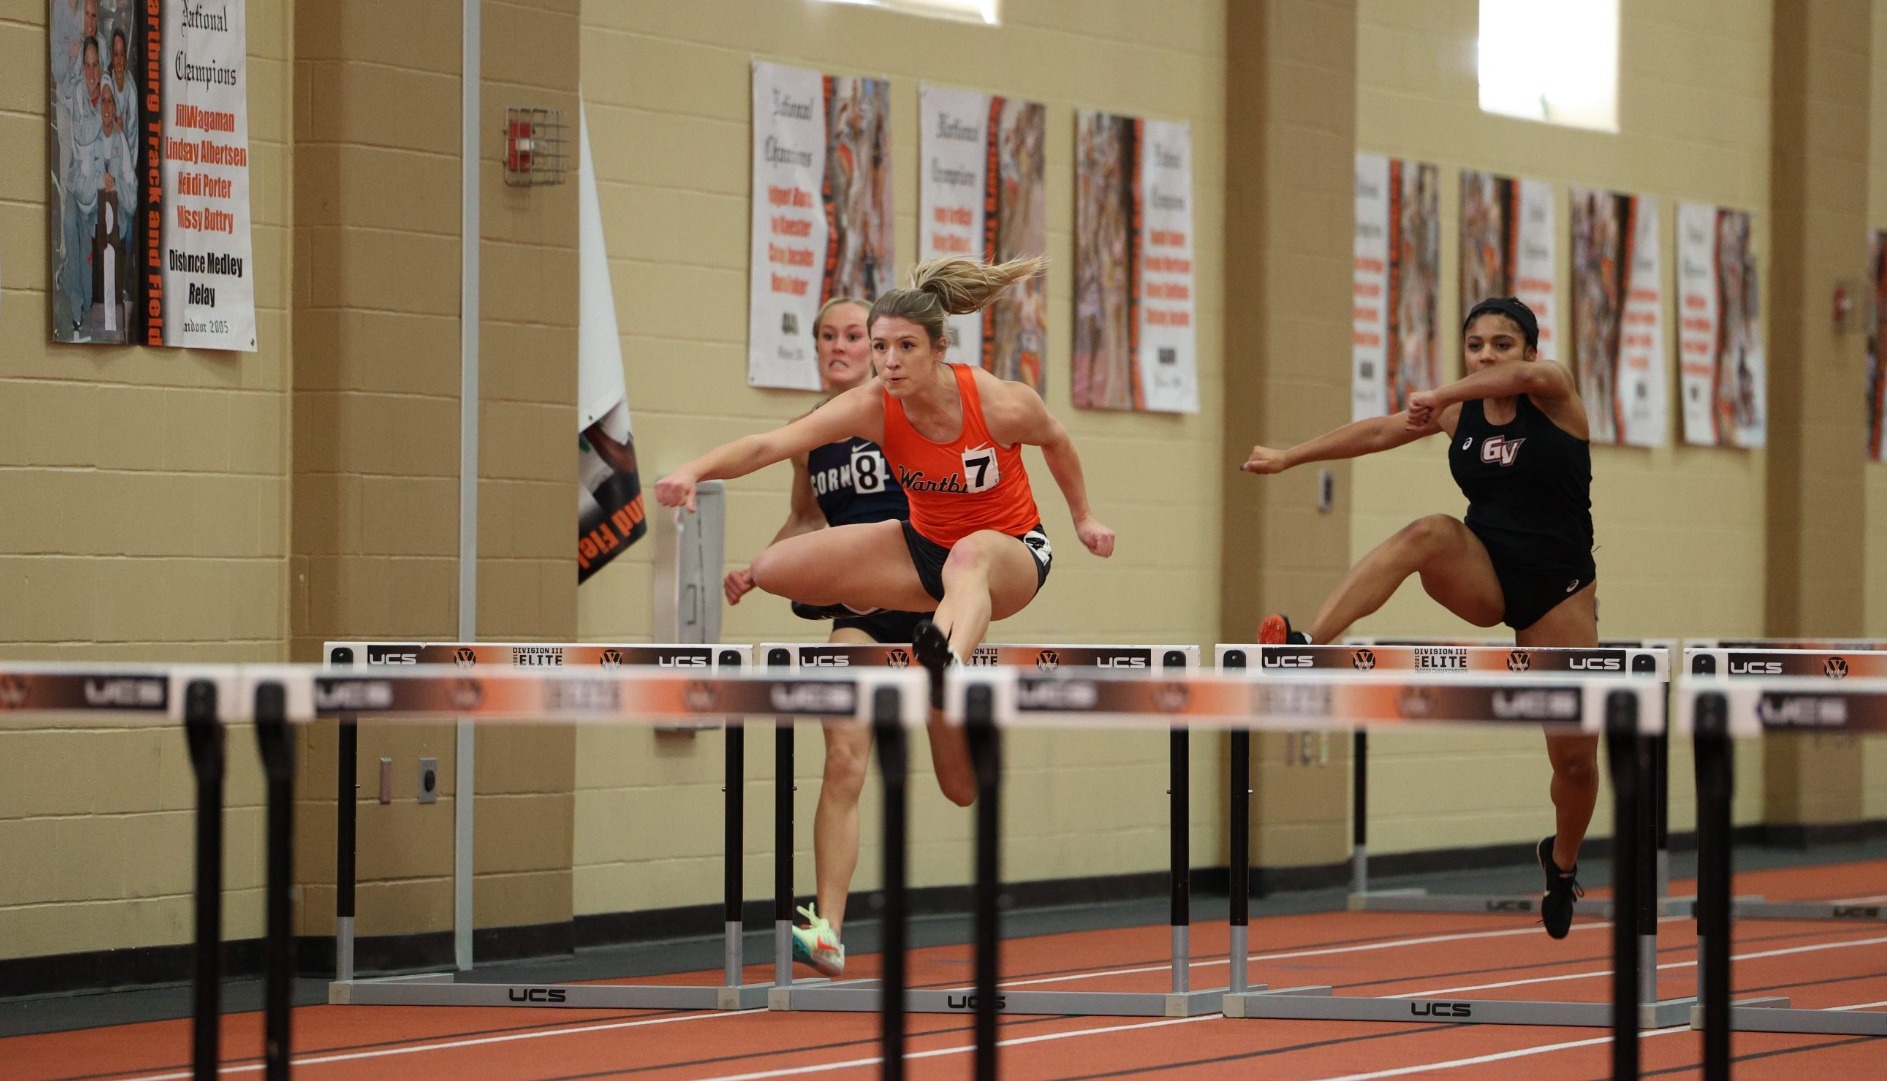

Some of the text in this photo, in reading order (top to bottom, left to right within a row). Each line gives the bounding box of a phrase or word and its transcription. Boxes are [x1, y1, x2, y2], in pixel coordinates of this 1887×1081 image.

[165, 136, 247, 167] Lindsay Albertsen
[148, 119, 162, 202] Track
[203, 174, 232, 199] Porter
[204, 207, 234, 235] Buttry
[148, 210, 161, 267] and
[207, 252, 243, 278] Medley
[188, 282, 216, 308] Relay
[148, 274, 163, 346] Field
[209, 320, 229, 334] 2005
[1481, 434, 1527, 467] GV
[810, 457, 891, 497] CORNL
[855, 454, 879, 491] 8
[965, 455, 991, 488] 7
[512, 647, 550, 655] DIVISION
[1414, 648, 1467, 656] DIVISION III
[368, 653, 417, 666] UCS
[519, 654, 563, 667] ELITE
[658, 656, 707, 668] UCS
[801, 655, 850, 668] UCS
[1096, 656, 1146, 669] UCS
[1264, 655, 1314, 668] UCS
[1421, 655, 1467, 668] ELITE
[1569, 657, 1620, 670] UCS
[1730, 661, 1783, 675] UCS
[508, 988, 567, 1003] UCS
[1410, 1002, 1472, 1017] UCS
